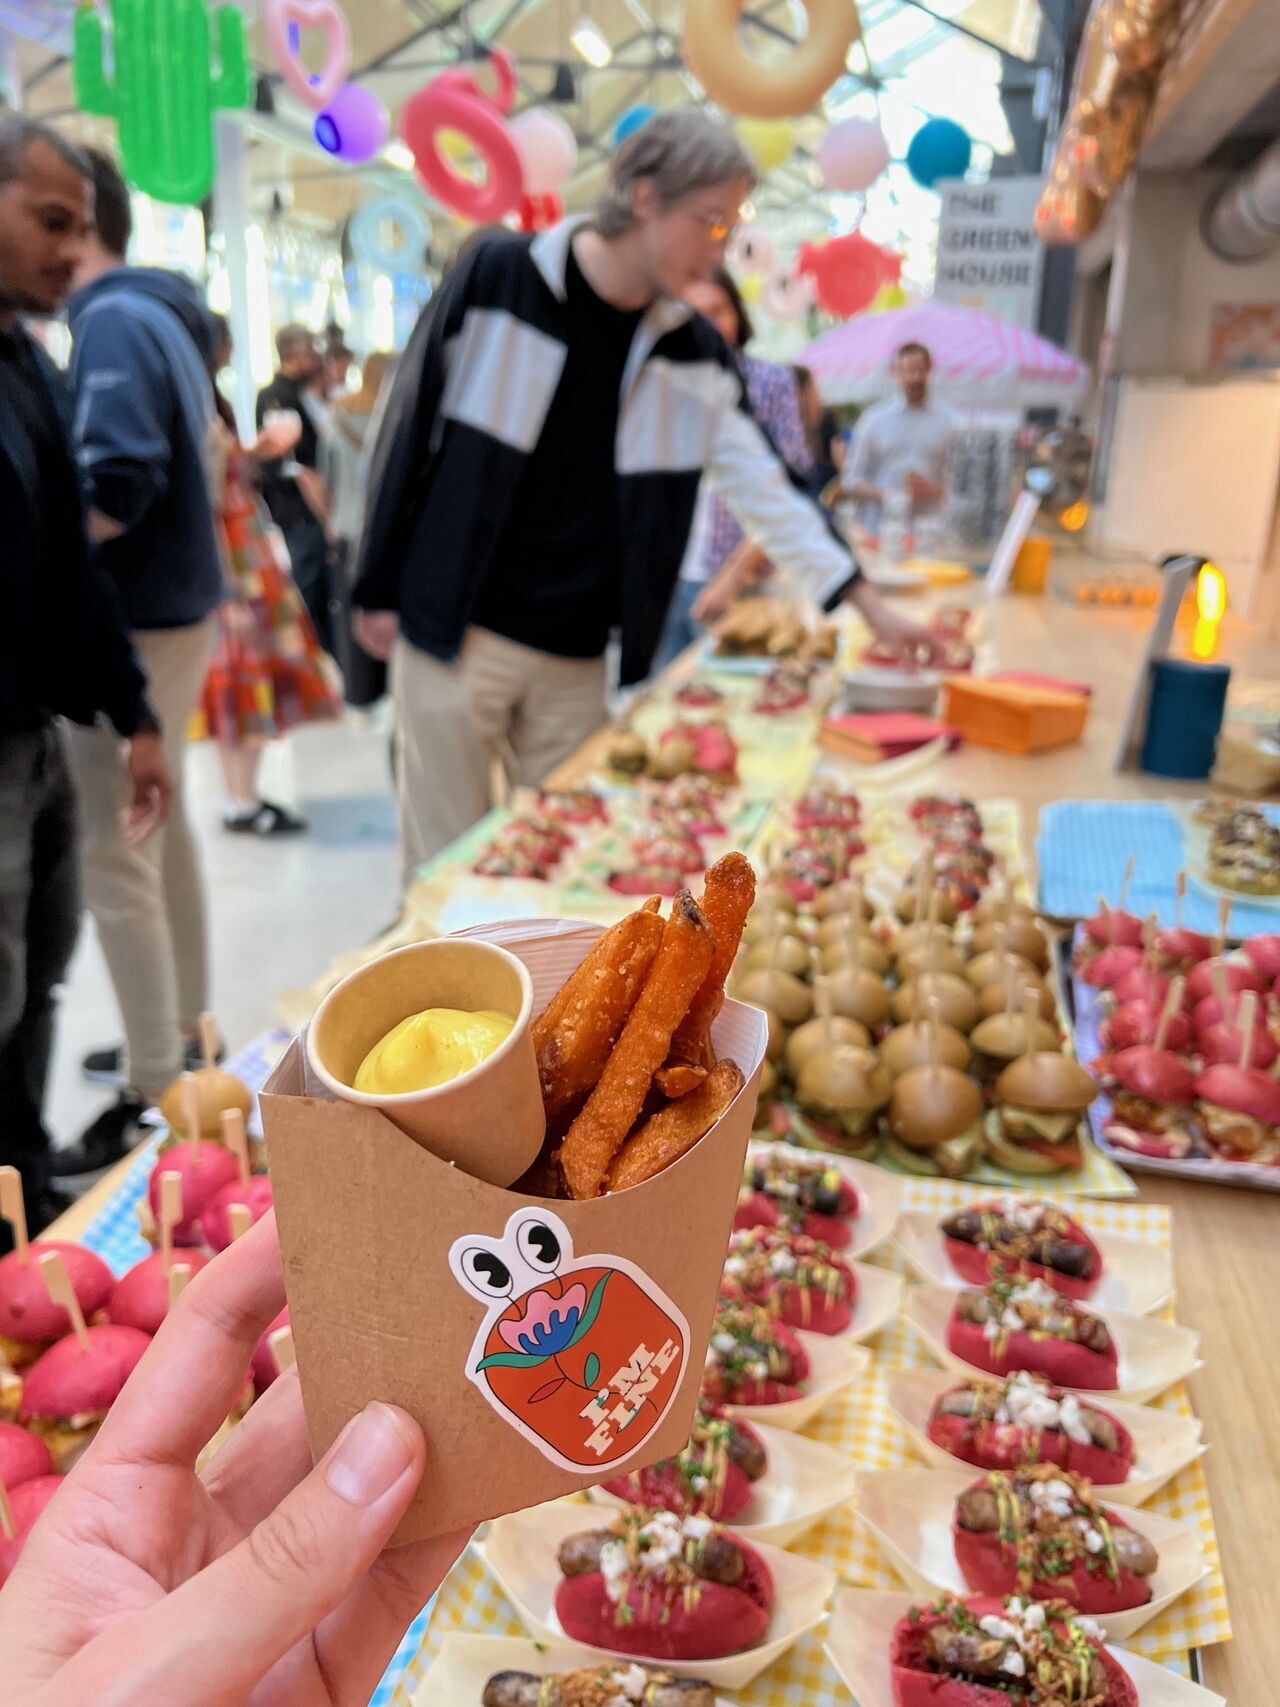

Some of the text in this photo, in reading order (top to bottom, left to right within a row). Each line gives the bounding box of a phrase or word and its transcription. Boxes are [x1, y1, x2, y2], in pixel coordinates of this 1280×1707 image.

[948, 191, 999, 216] THE
[945, 227, 1033, 252] GREEN
[941, 261, 1031, 287] HOUSE
[583, 1338, 680, 1456] FINE
